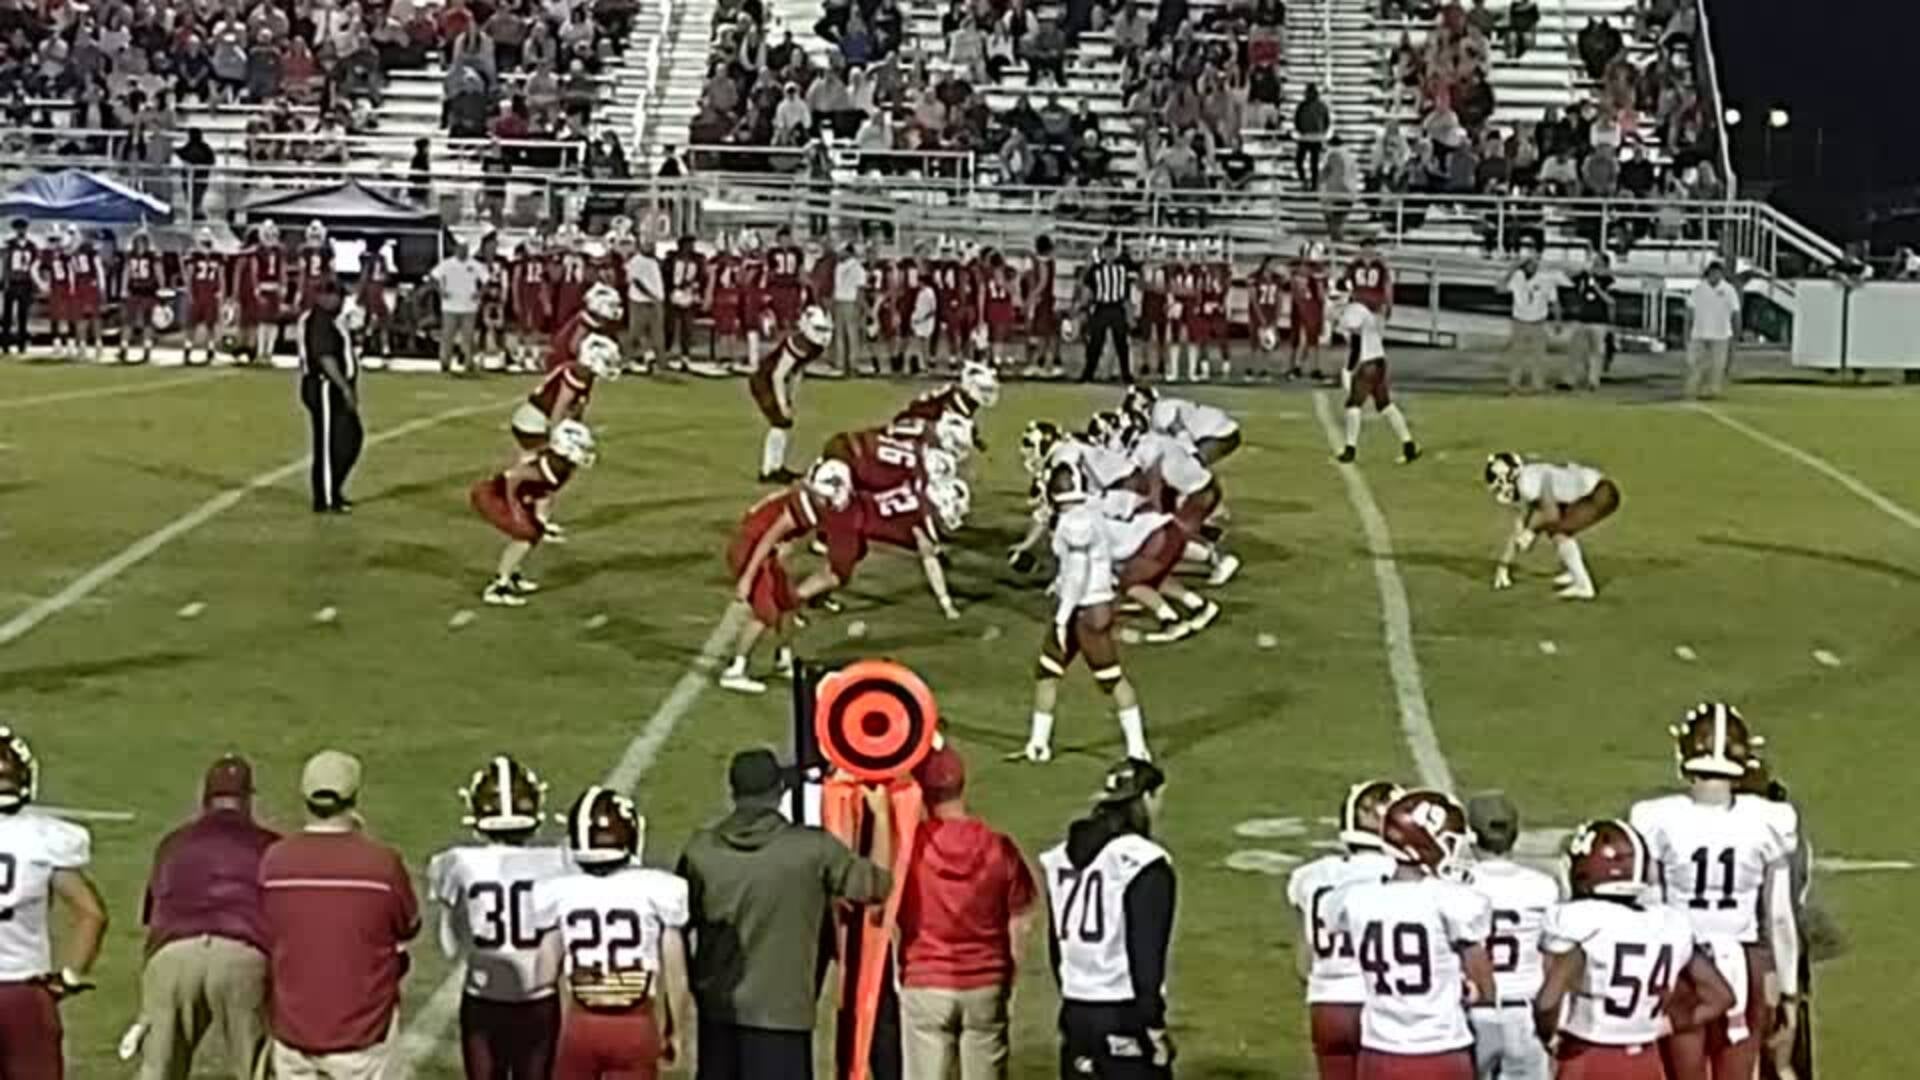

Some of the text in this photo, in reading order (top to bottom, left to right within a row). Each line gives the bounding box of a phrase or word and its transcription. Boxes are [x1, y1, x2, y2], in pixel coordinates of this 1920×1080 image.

[1058, 866, 1104, 943] 70
[1688, 846, 1738, 910] 11
[469, 880, 546, 949] 30
[566, 908, 641, 972] 22
[1359, 920, 1432, 995] 49
[1604, 942, 1673, 1020] 54
